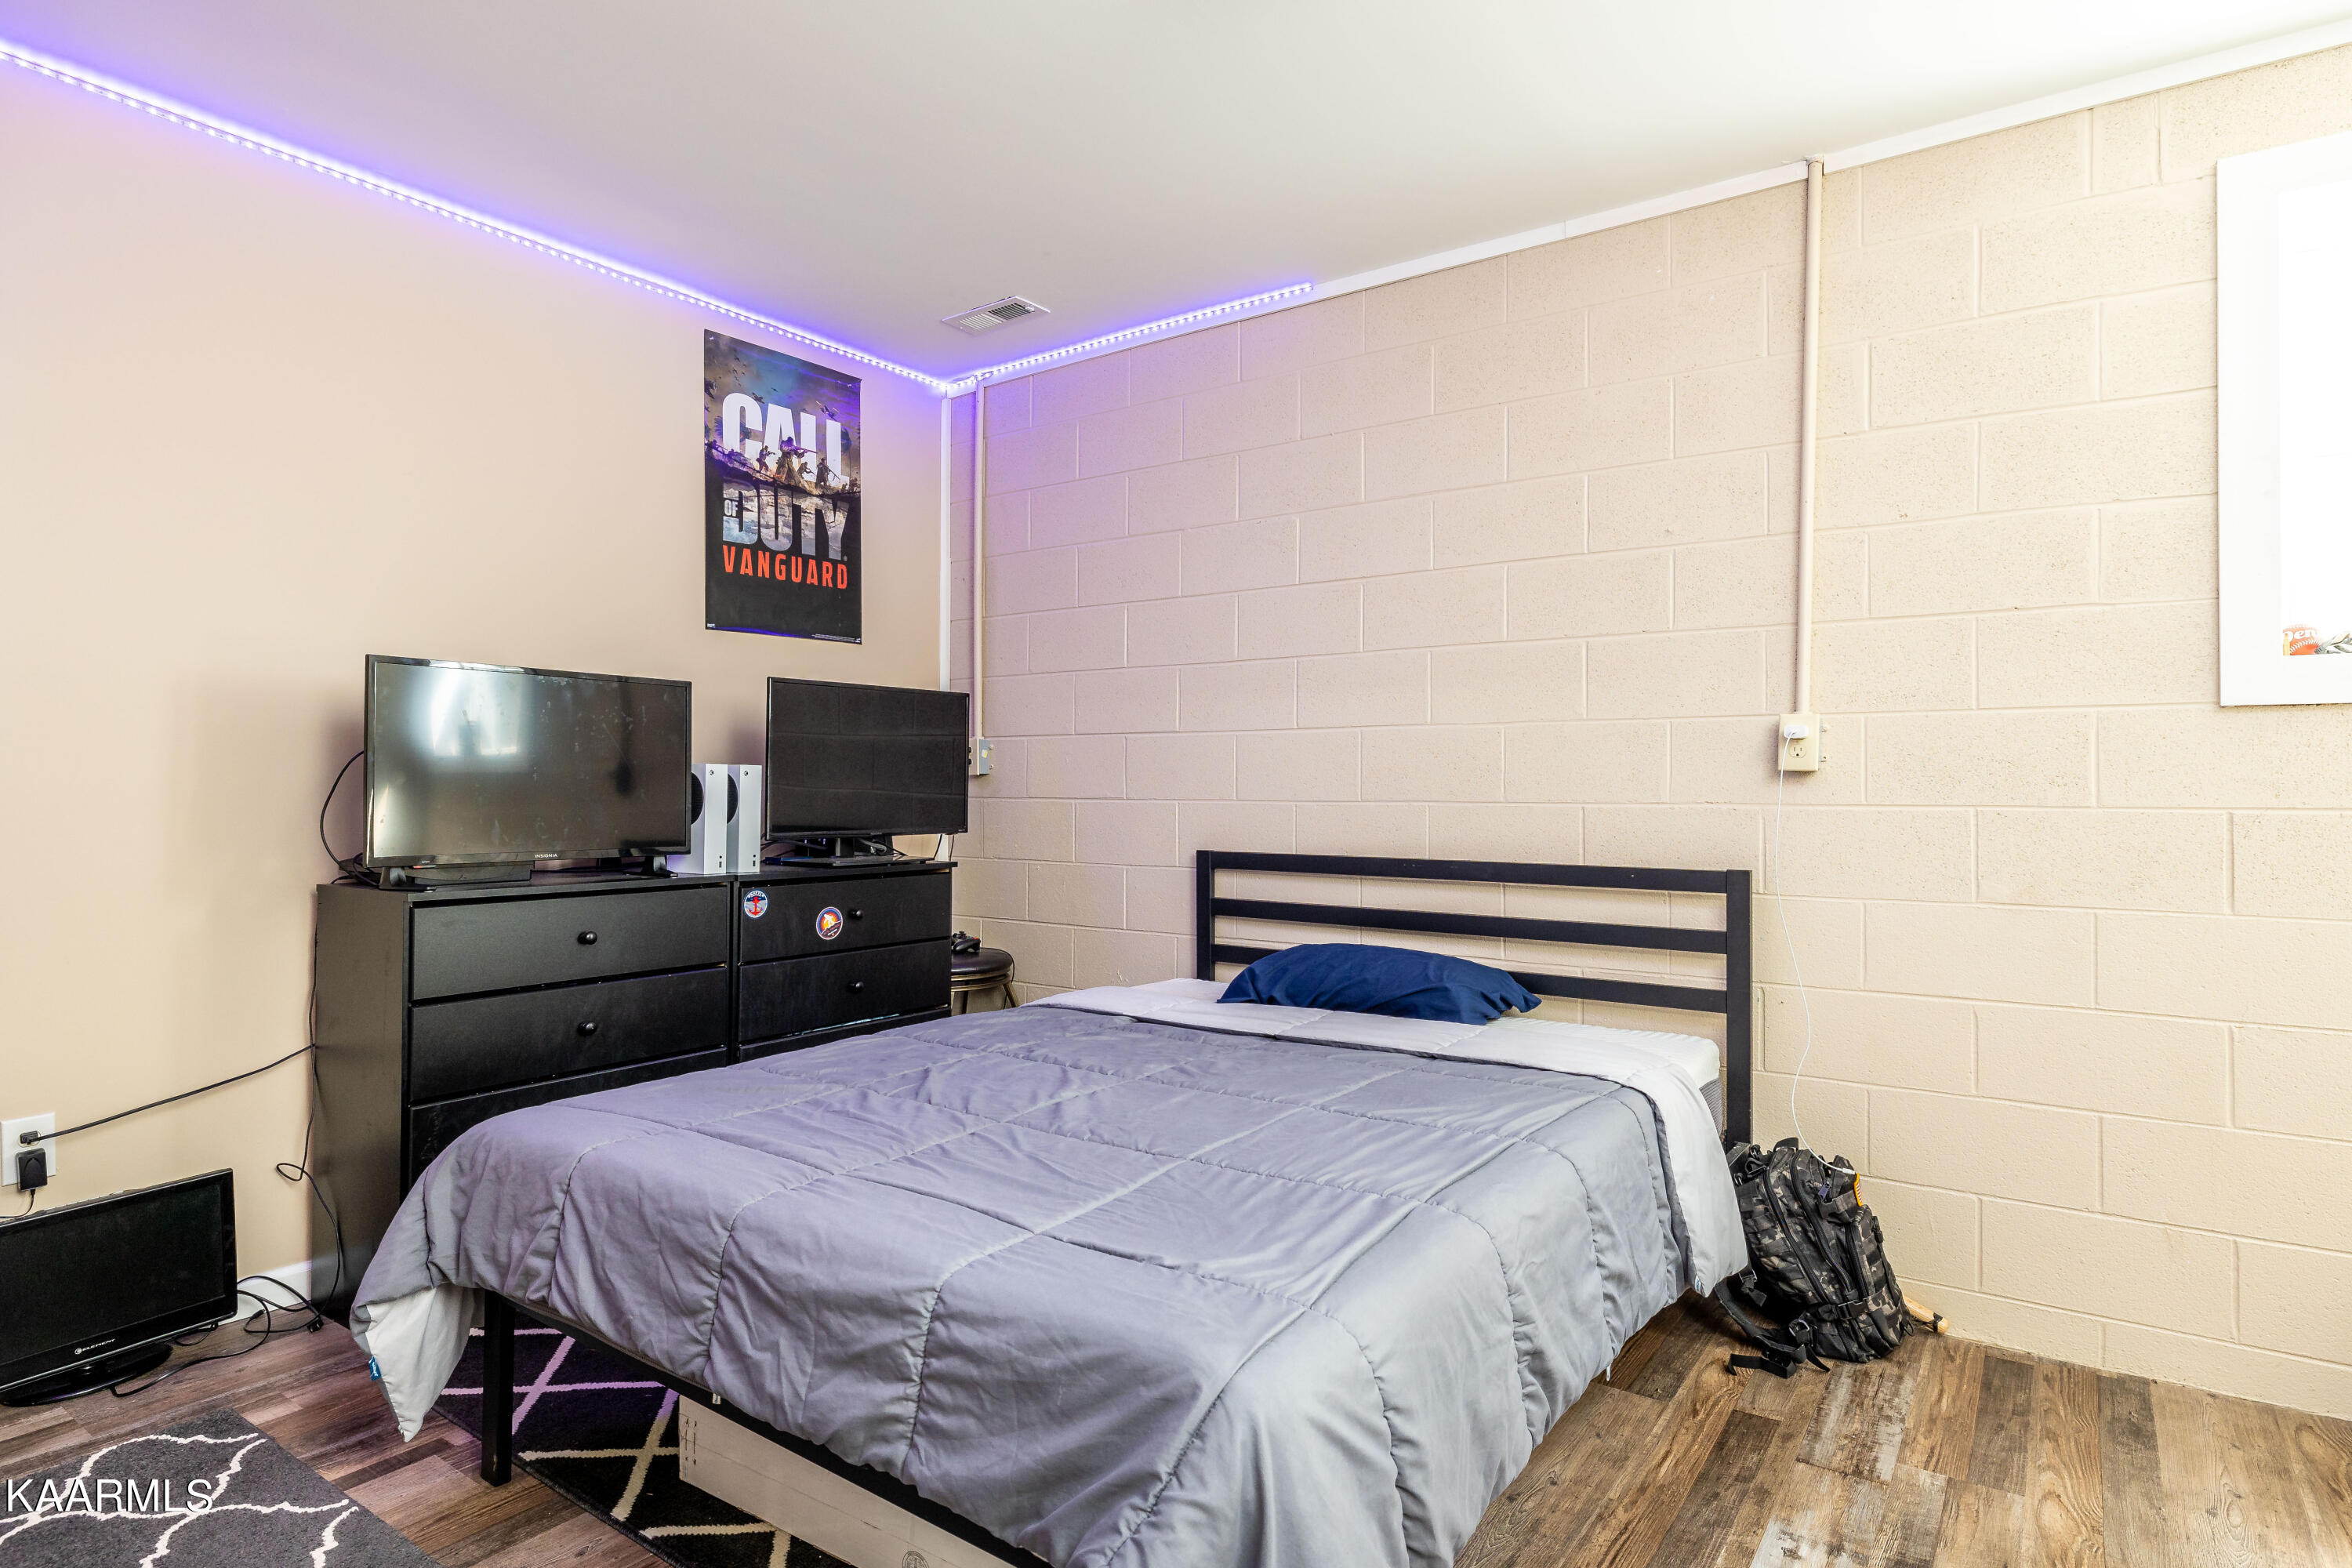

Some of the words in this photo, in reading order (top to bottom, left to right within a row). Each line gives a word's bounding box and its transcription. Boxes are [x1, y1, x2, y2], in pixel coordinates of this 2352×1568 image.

[722, 392, 850, 489] CALL
[722, 481, 850, 561] DUTY
[724, 499, 739, 517] OF
[722, 545, 848, 590] VANGUARD
[82, 1338, 116, 1351] ELEMENT
